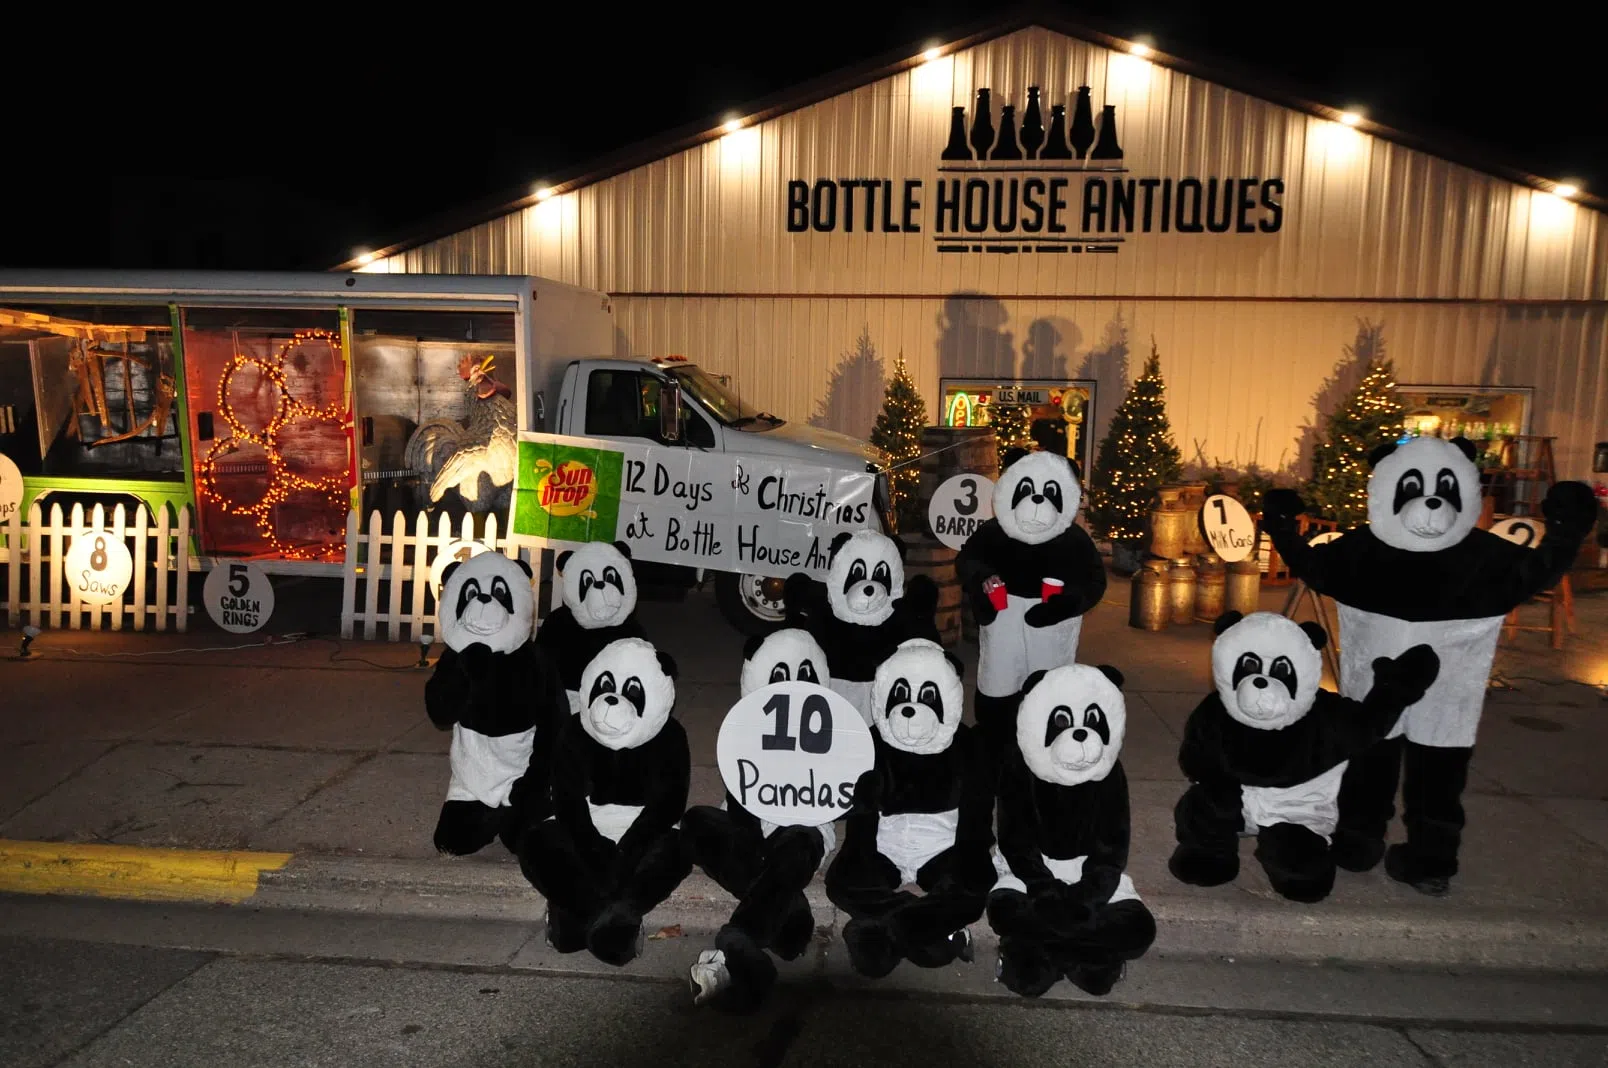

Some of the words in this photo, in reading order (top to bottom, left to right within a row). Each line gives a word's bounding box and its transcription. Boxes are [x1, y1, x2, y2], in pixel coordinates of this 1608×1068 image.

[788, 179, 922, 232] BOTTLE
[936, 178, 1068, 233] HOUSE
[1082, 178, 1284, 233] ANTIQUES
[1017, 391, 1042, 403] MAIL
[548, 463, 592, 486] Sun
[541, 485, 589, 506] Drop
[626, 460, 646, 493] 12
[654, 462, 713, 510] Days
[758, 475, 868, 525] Christmas
[954, 478, 978, 516] 3
[90, 536, 107, 571] 8
[626, 512, 654, 539] at
[665, 517, 723, 556] Bottle
[738, 524, 801, 567] House
[79, 569, 119, 597] Saws
[228, 564, 250, 598] 5
[220, 596, 260, 613] GOLDEN
[223, 610, 259, 627] RINGS
[762, 693, 833, 754] 10
[737, 758, 855, 809] Pandas
